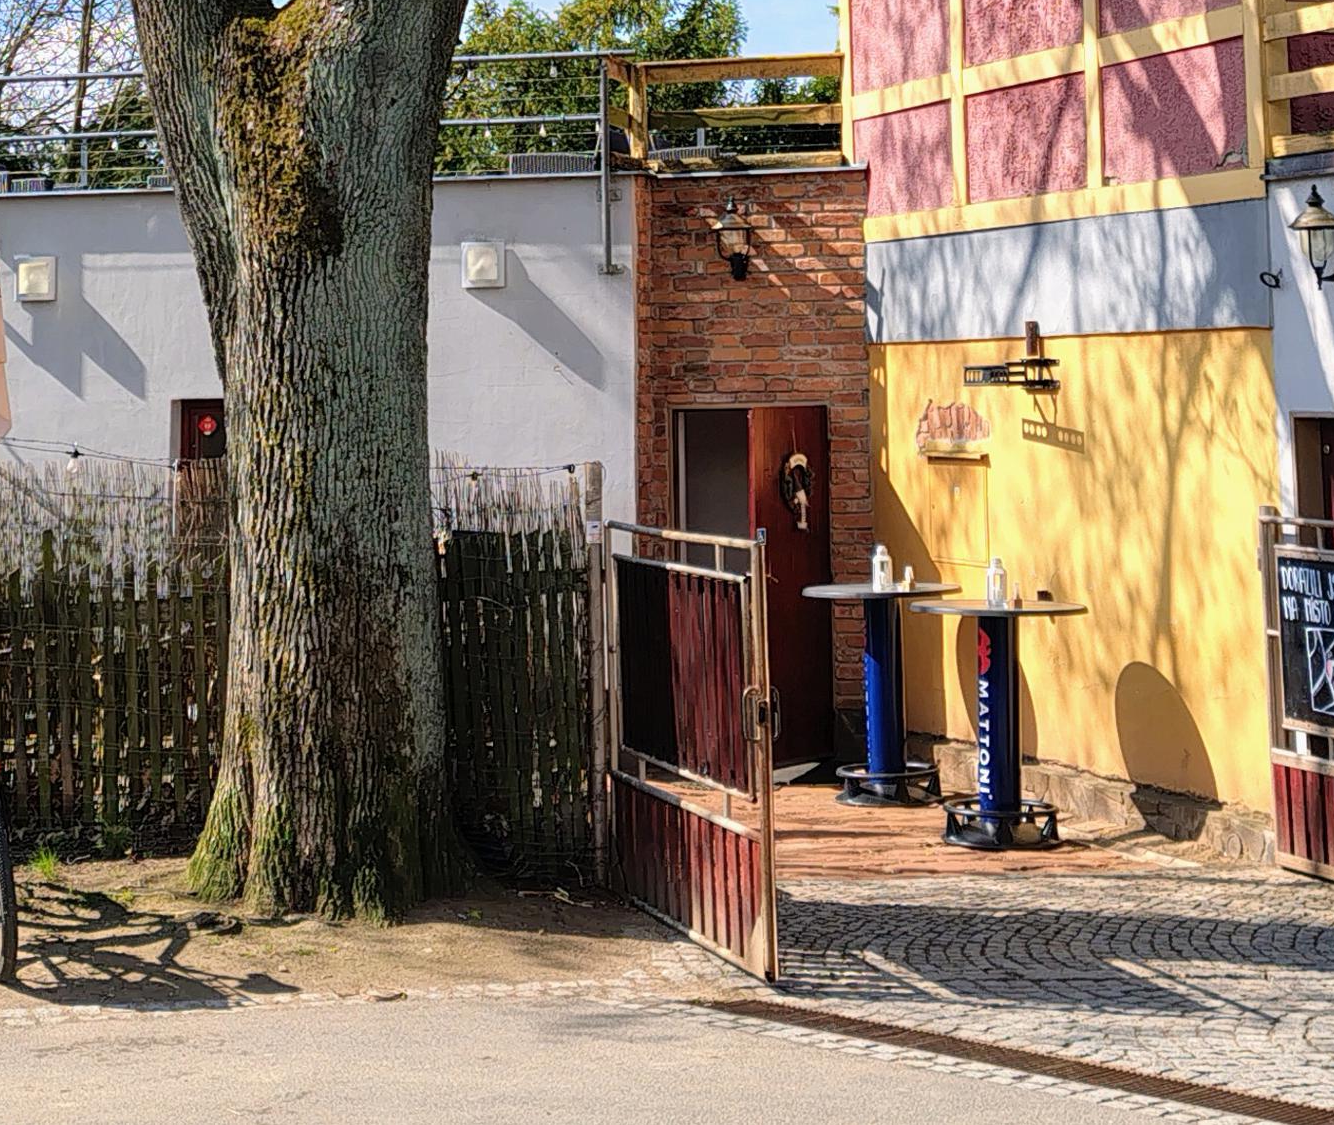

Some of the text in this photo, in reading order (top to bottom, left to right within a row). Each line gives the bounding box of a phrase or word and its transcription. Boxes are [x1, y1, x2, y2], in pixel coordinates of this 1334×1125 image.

[1280, 566, 1323, 598] DORAZILI
[1283, 596, 1299, 621] NA
[1304, 597, 1331, 625] MÍSTO
[978, 679, 991, 795] MATTONI
